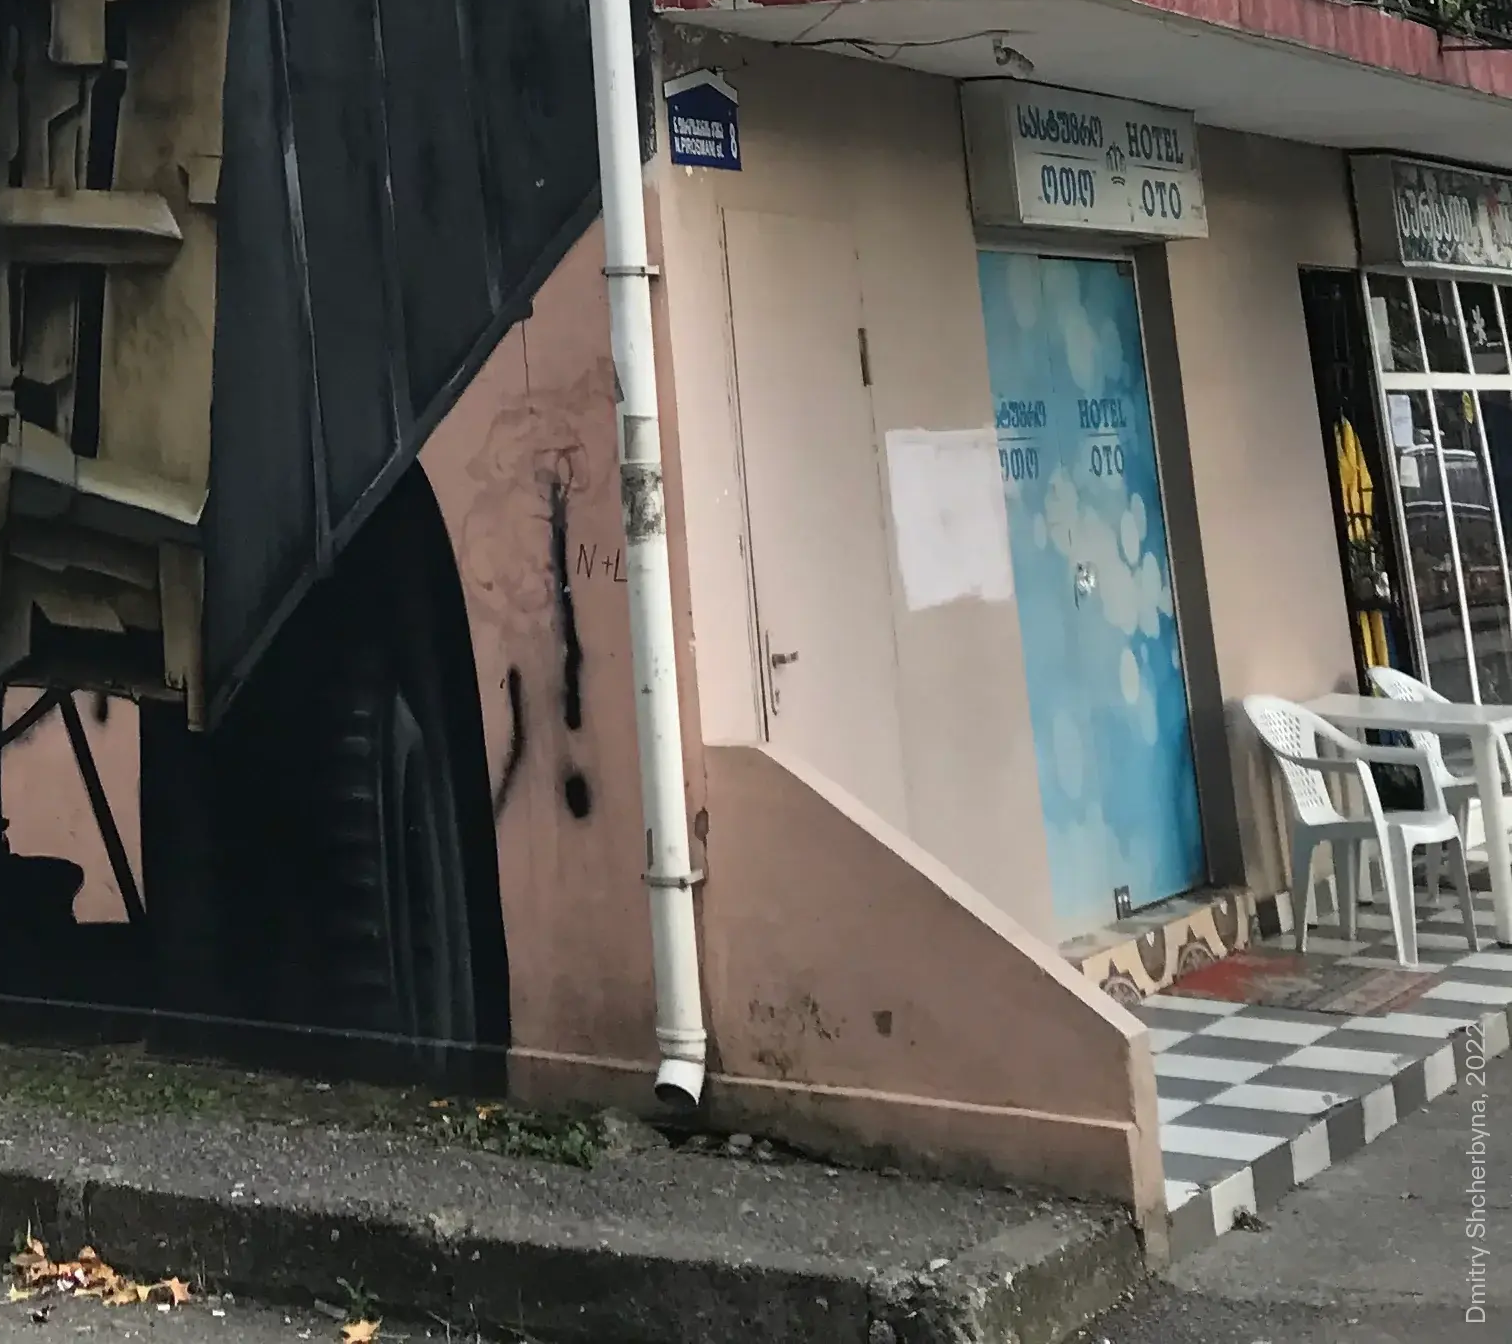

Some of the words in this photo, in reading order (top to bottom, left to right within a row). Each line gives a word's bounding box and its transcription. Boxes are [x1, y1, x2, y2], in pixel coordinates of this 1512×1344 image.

[729, 123, 738, 160] 8
[1017, 104, 1103, 148] სასტუმრო
[1126, 122, 1184, 164] HOTEL
[1041, 165, 1094, 208] ოთო
[1142, 179, 1181, 220] OTO
[1078, 398, 1127, 429] HOTEL
[1091, 444, 1125, 477] OTO
